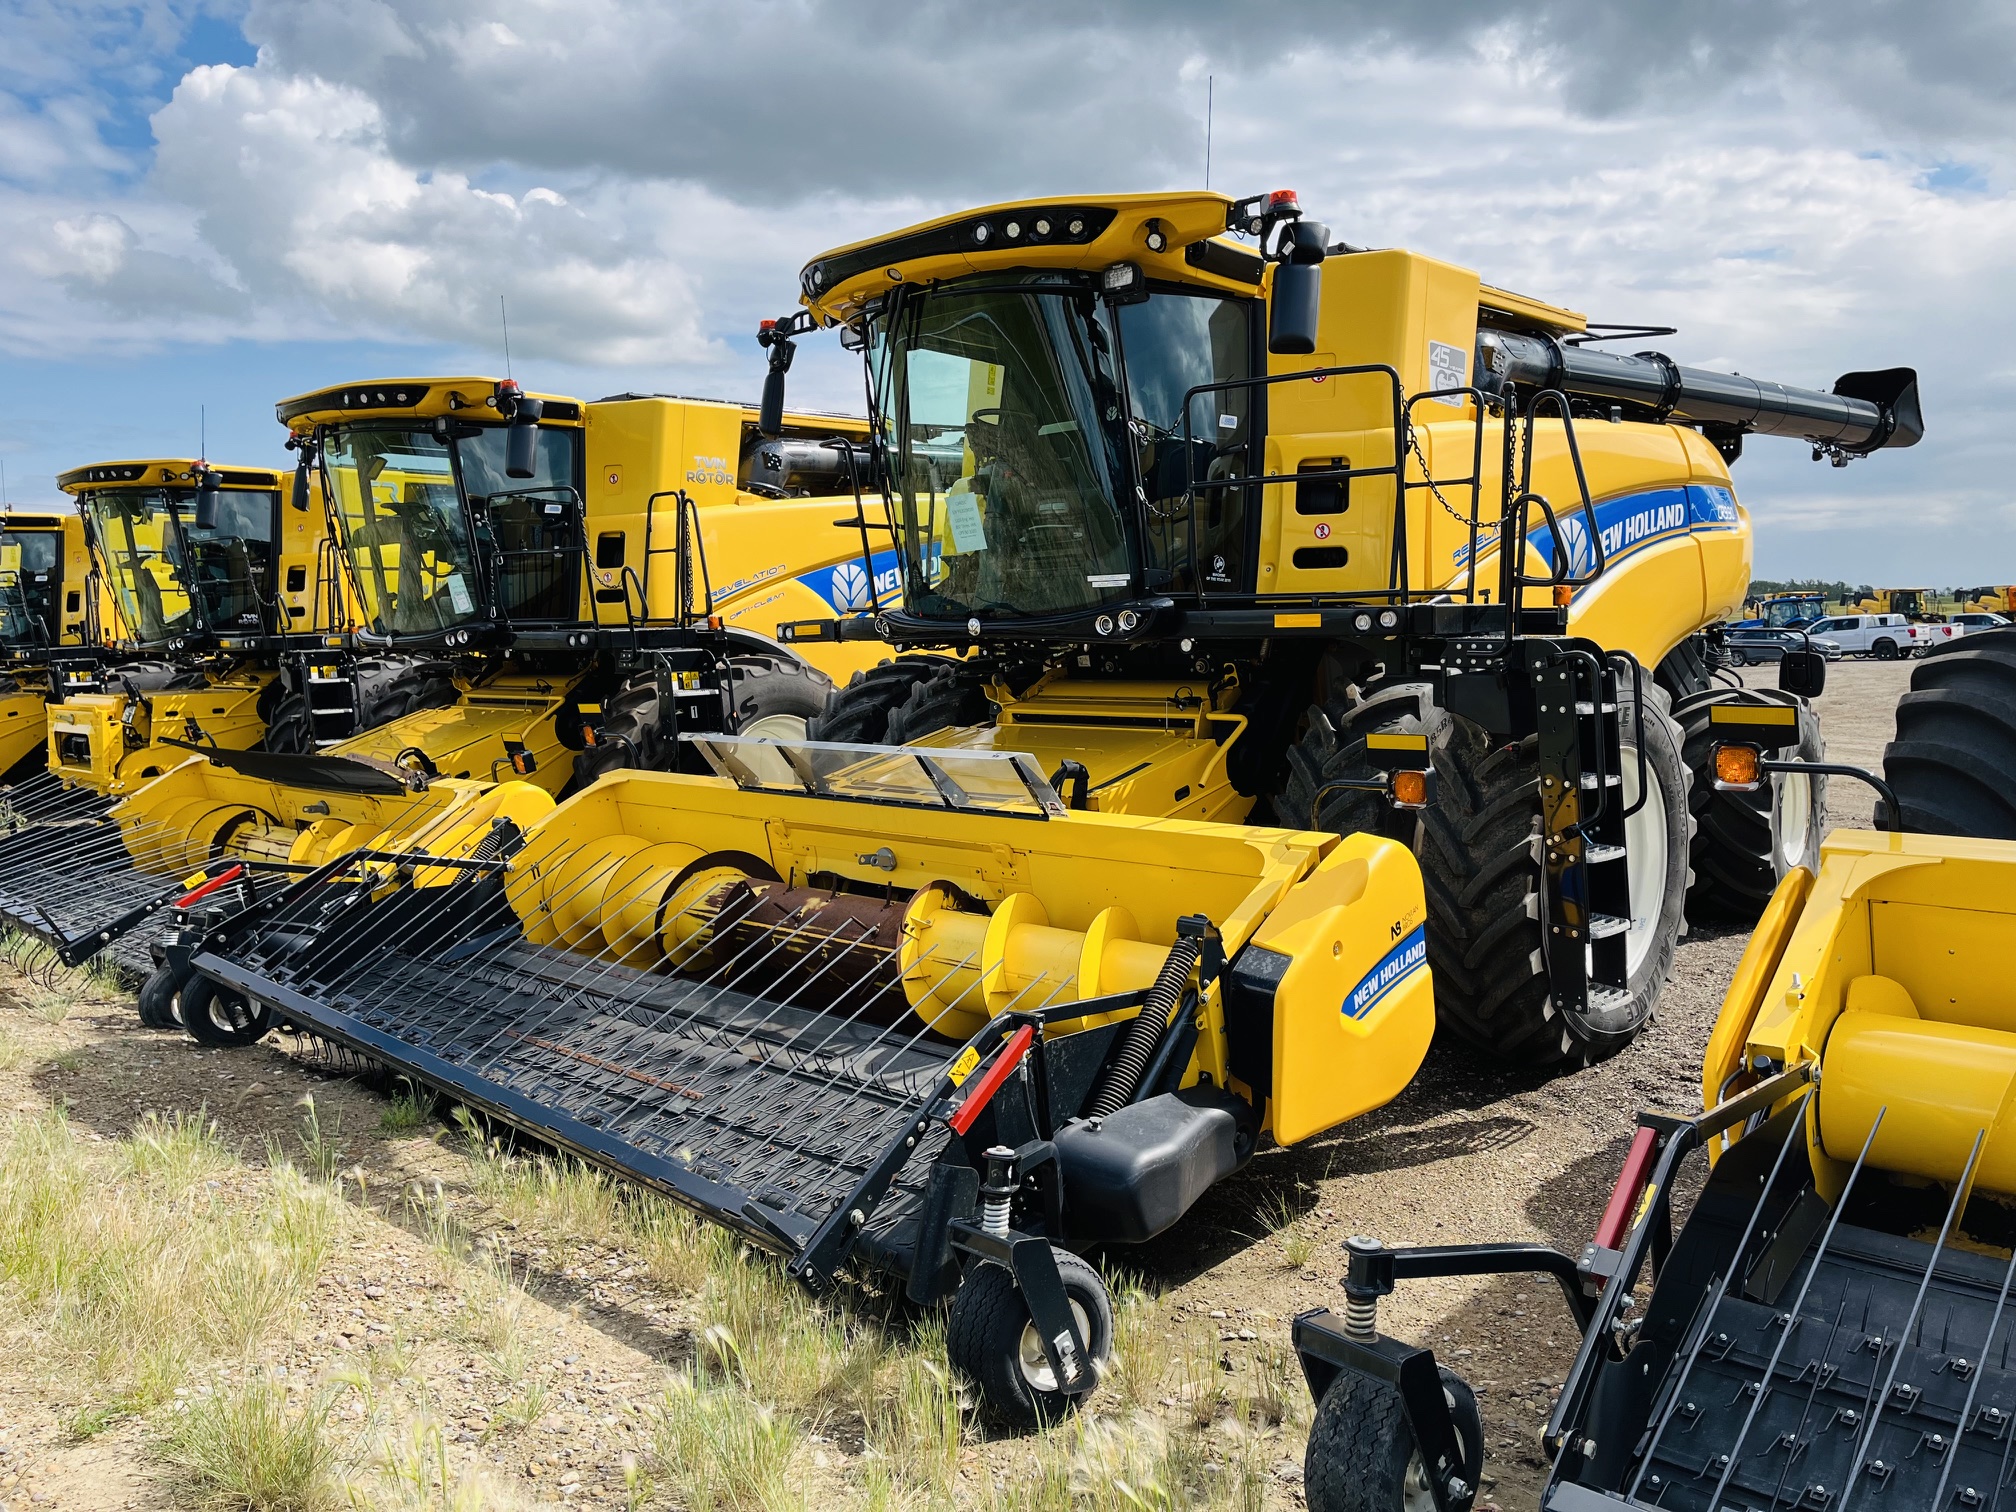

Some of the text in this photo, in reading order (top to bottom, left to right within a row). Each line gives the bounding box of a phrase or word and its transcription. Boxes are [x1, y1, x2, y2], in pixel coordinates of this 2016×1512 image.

[1430, 346, 1450, 368] 45
[686, 468, 734, 485] ROTOR
[693, 456, 727, 470] TWIN
[1625, 503, 1684, 545] HOLLAND
[710, 564, 786, 597] REVELATION
[730, 592, 784, 620] OPTI-CLEAN
[1353, 940, 1426, 1010] NEW HOLLAND
[1624, 934, 1670, 1022] ALLIANCE
